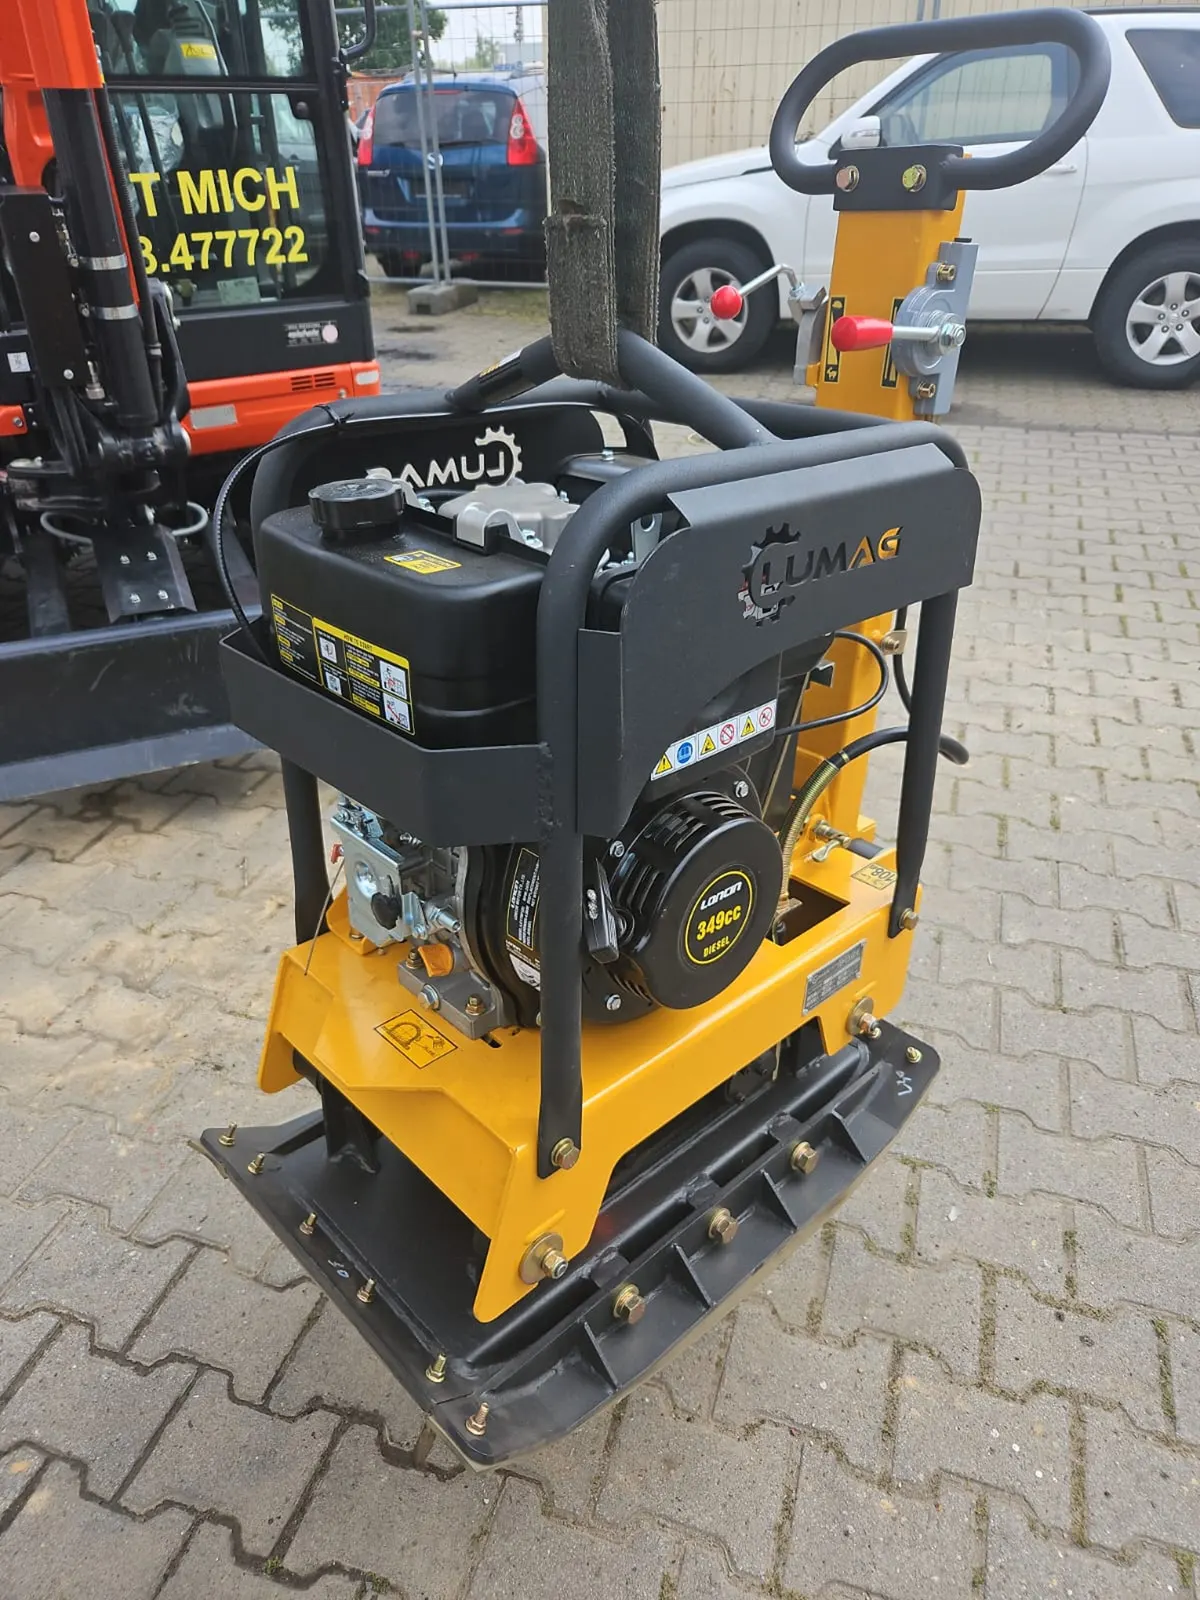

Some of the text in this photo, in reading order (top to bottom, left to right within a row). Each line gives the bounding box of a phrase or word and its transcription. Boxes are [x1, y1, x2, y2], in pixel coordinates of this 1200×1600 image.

[128, 166, 300, 217] T MICH
[760, 526, 904, 597] LUMAG
[703, 935, 730, 958] DIESEL
